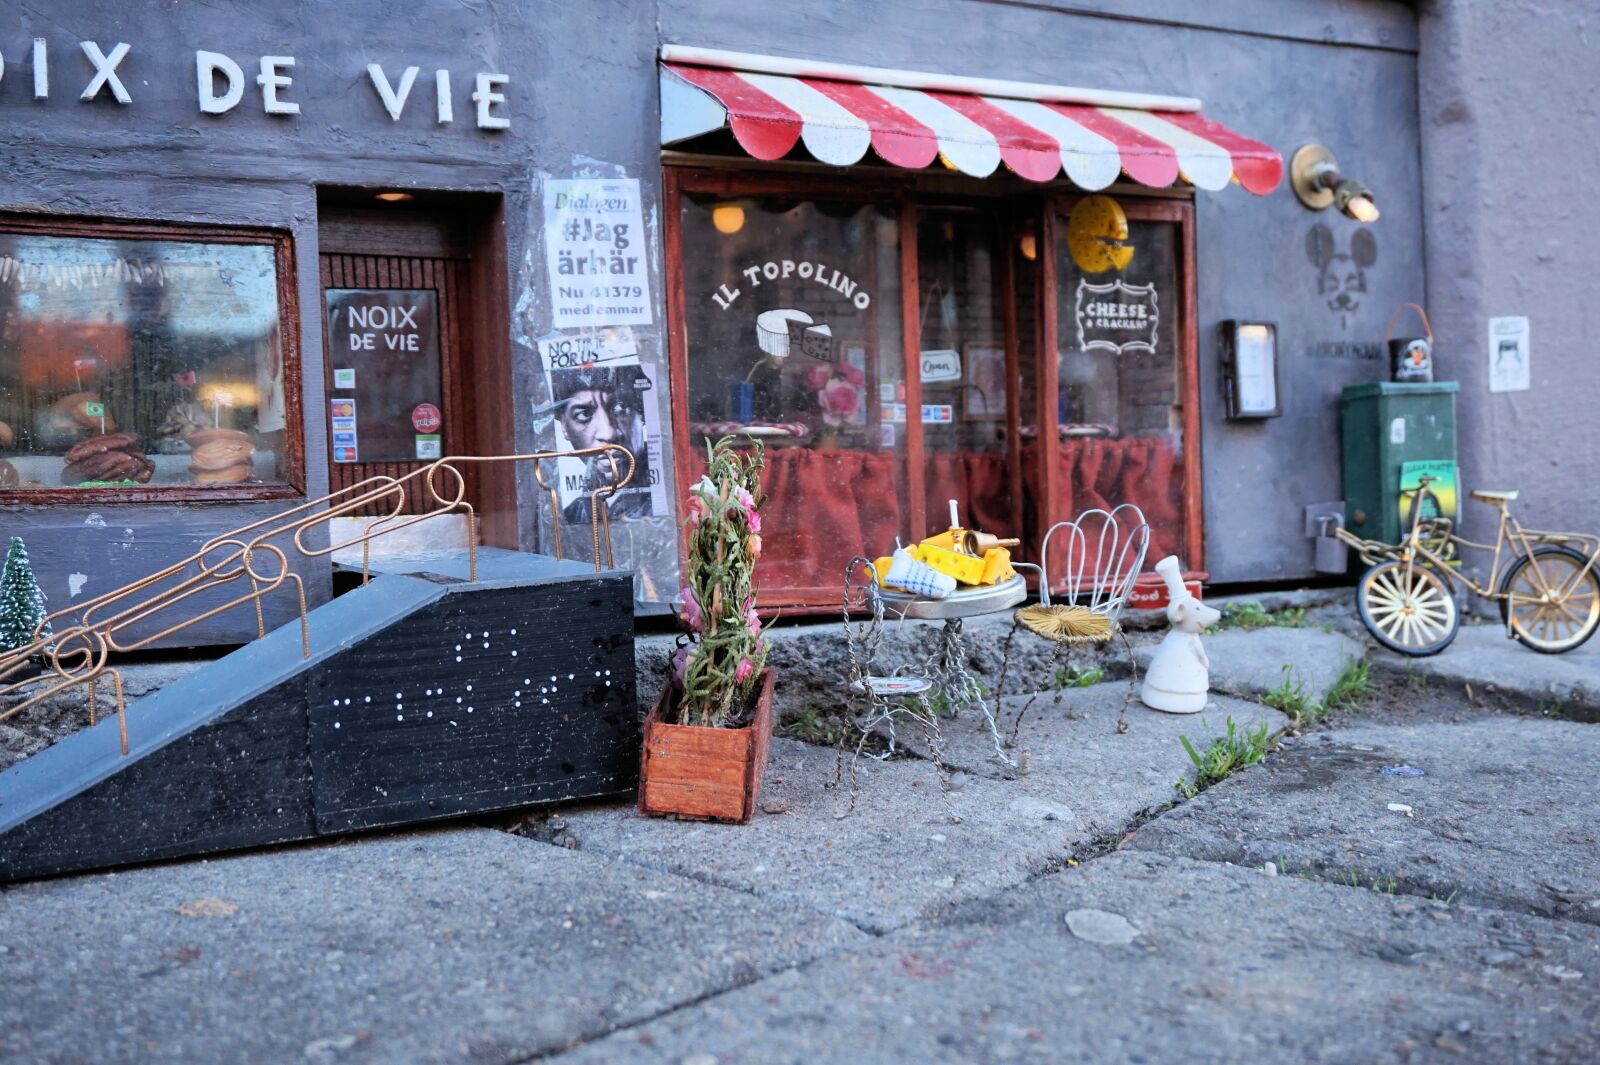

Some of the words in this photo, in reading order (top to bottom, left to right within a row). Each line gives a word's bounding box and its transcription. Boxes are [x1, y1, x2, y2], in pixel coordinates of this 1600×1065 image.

[0, 37, 132, 104] IX
[196, 50, 300, 114] DE
[367, 64, 510, 130] VIE
[555, 193, 628, 214] Dialogen
[562, 218, 630, 249] #Jag
[559, 286, 584, 299] Nu
[712, 284, 741, 310] IL
[743, 260, 870, 310] TOPOLINO
[348, 306, 418, 329] NOIX
[1086, 303, 1147, 318] CHEESE
[350, 333, 376, 351] DE
[384, 333, 420, 351] VIE
[549, 341, 571, 357] NO
[551, 352, 578, 367] FOR
